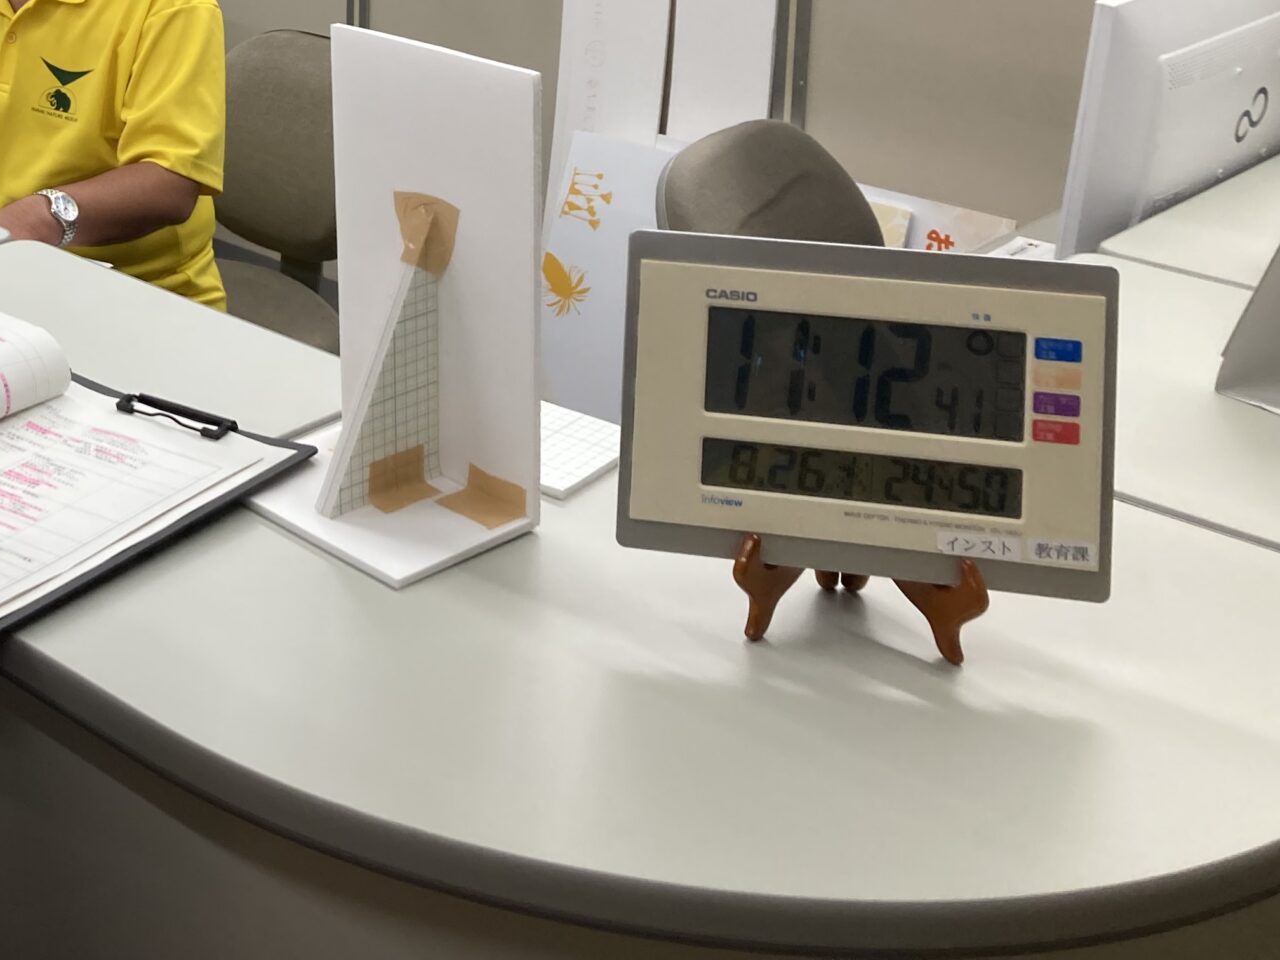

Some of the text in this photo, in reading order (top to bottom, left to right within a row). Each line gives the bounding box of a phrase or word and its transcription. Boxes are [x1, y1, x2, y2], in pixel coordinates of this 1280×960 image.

[705, 288, 758, 302] CASIO
[946, 536, 1091, 562] インスト 教育課
